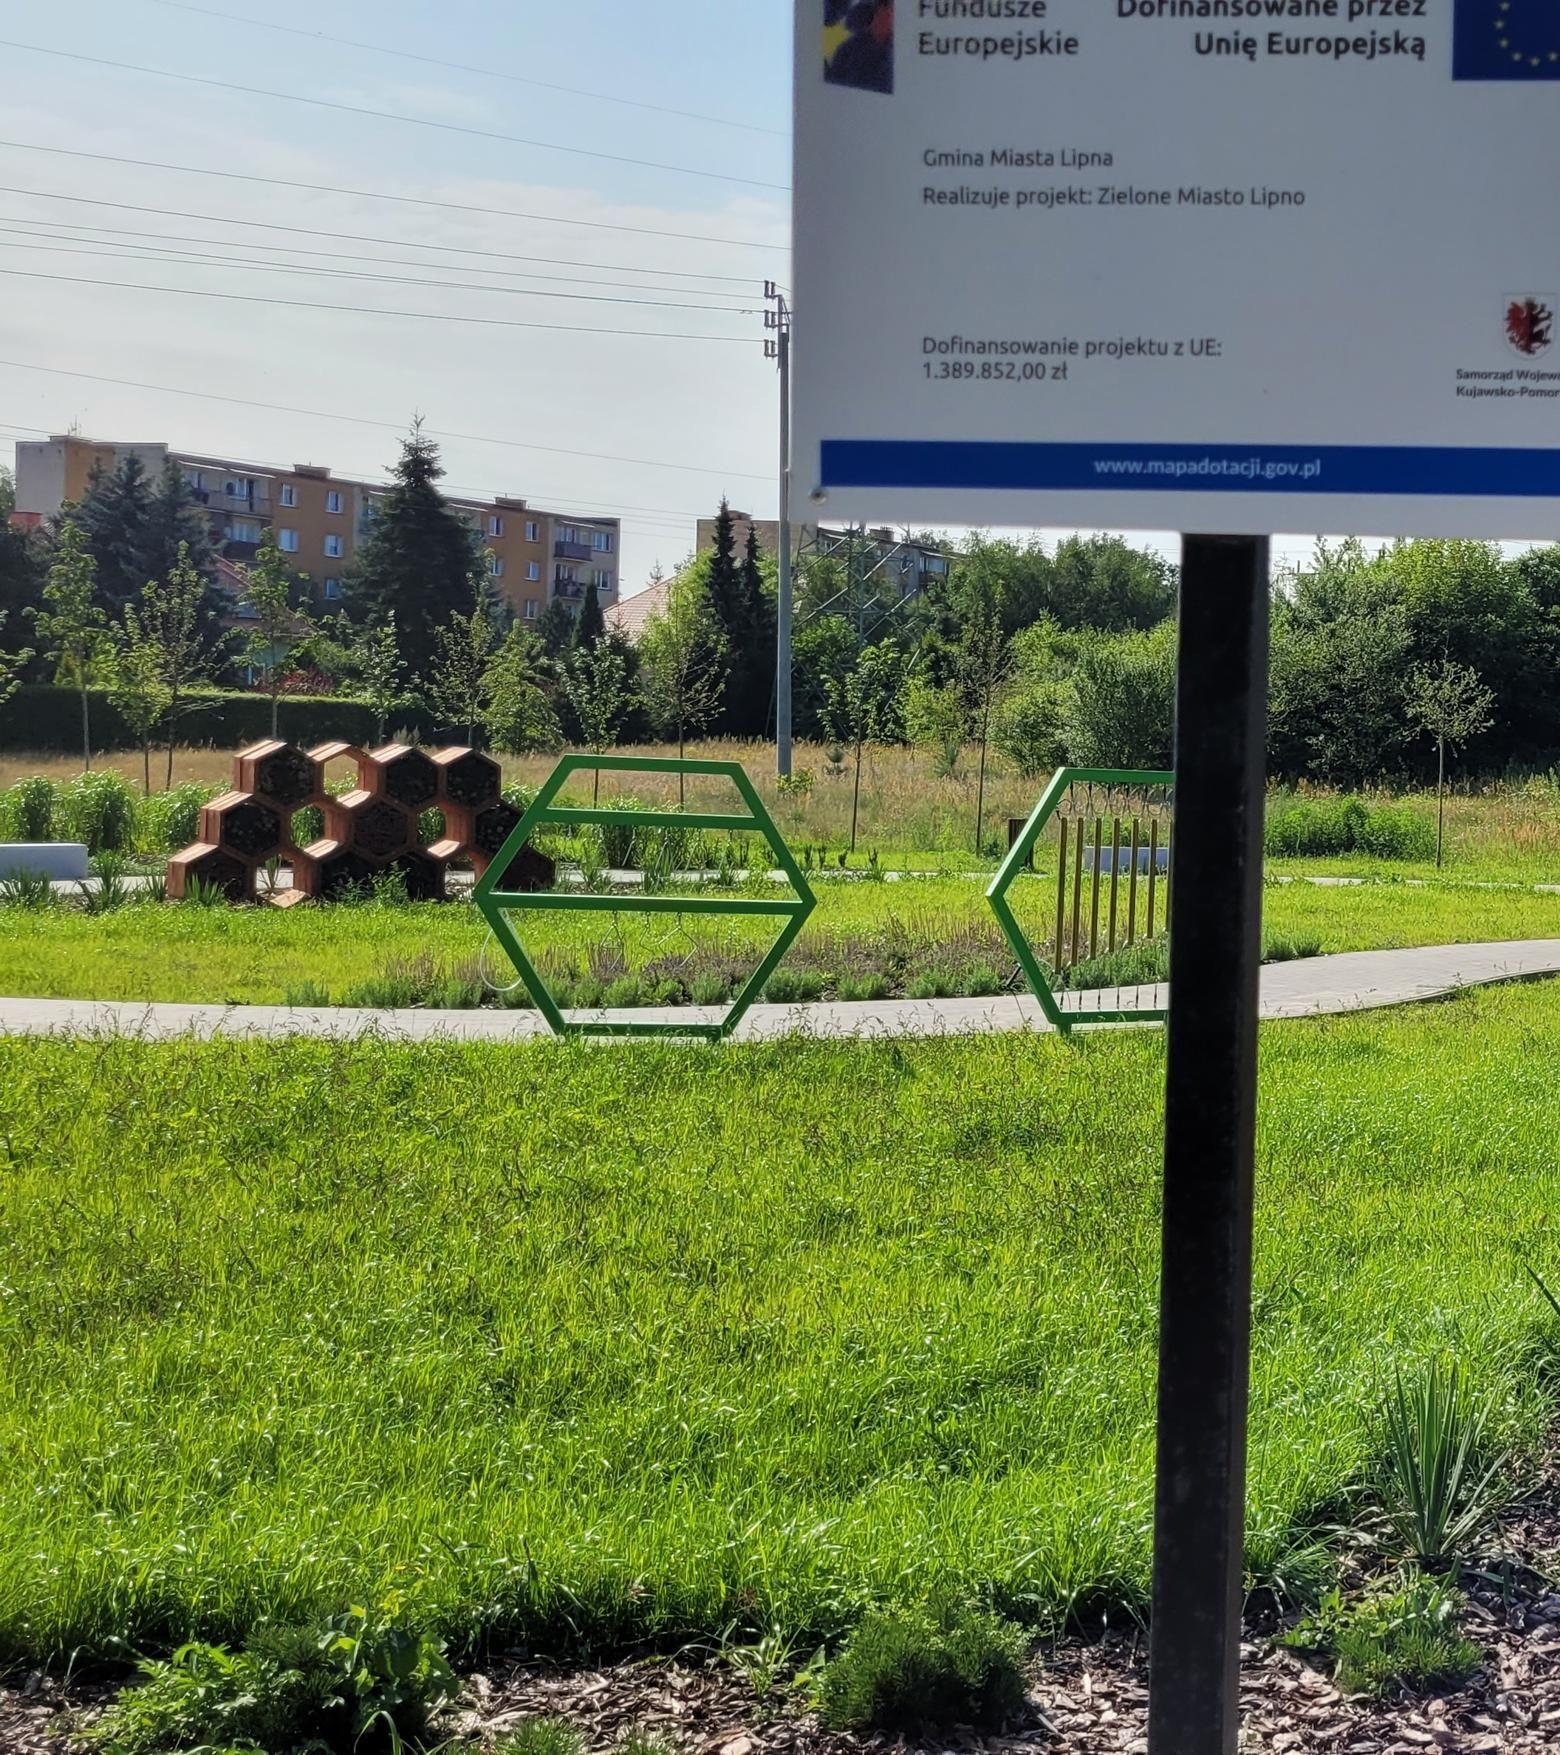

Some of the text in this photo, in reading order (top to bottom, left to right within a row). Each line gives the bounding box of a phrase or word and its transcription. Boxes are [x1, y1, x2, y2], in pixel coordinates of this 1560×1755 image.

[918, 0, 1047, 18] Fundusze
[1117, 0, 1427, 22] Dofinansowane przez
[918, 30, 1079, 60] Europejskie
[1194, 30, 1426, 61] Unię Europejską
[923, 149, 1113, 170] Gmina Miasta Lipna
[923, 186, 1305, 209] Realizuje projekt: Zielone Miasto Lipno
[922, 336, 1222, 360] Dofinansowanie projektu z UE:
[923, 361, 1068, 382] 1.389.852,00 zł
[1456, 369, 1513, 382] Samorząd
[1093, 457, 1321, 479] www.mapadotacji.gov.pl
